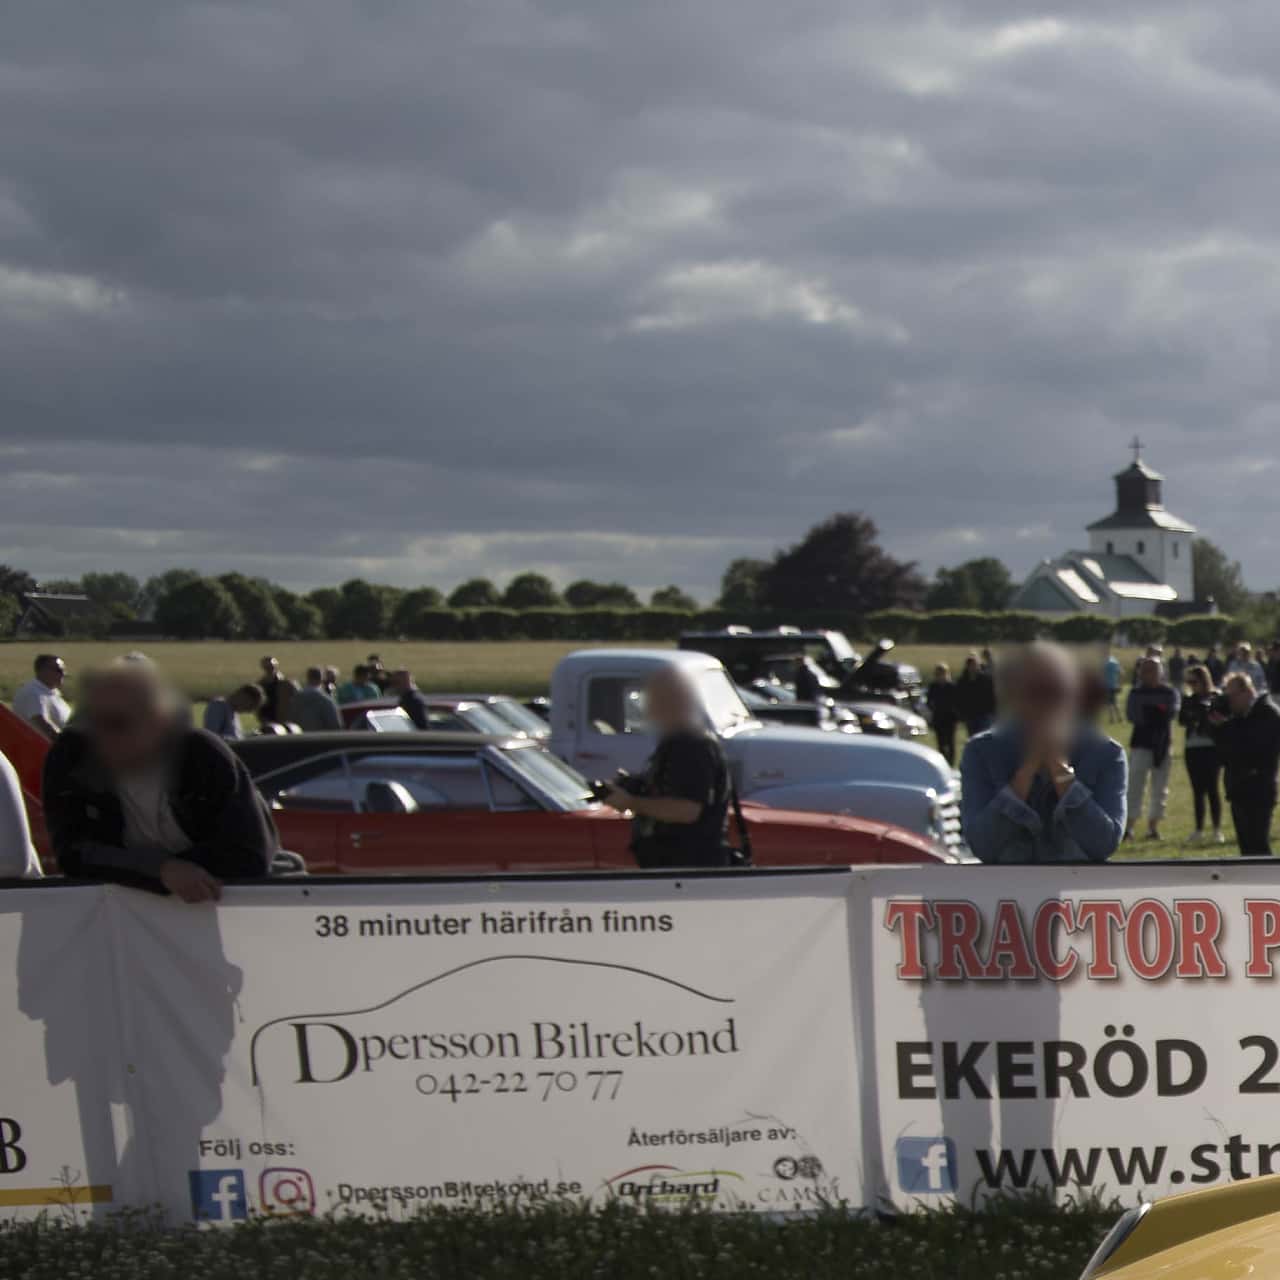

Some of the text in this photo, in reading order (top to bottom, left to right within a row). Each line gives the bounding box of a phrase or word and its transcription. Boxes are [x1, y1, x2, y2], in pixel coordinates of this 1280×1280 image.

[315, 908, 674, 938] 38 minuter härifrån finns
[887, 897, 1228, 981] TRACTOR
[290, 1018, 740, 1084] Dpersson Bilrekond
[896, 1024, 1208, 1100] EKERÖD
[415, 1069, 624, 1103] 042-22 70 77
[200, 1139, 296, 1160] Följ oss:
[627, 1126, 797, 1147] Återförsäljare av:
